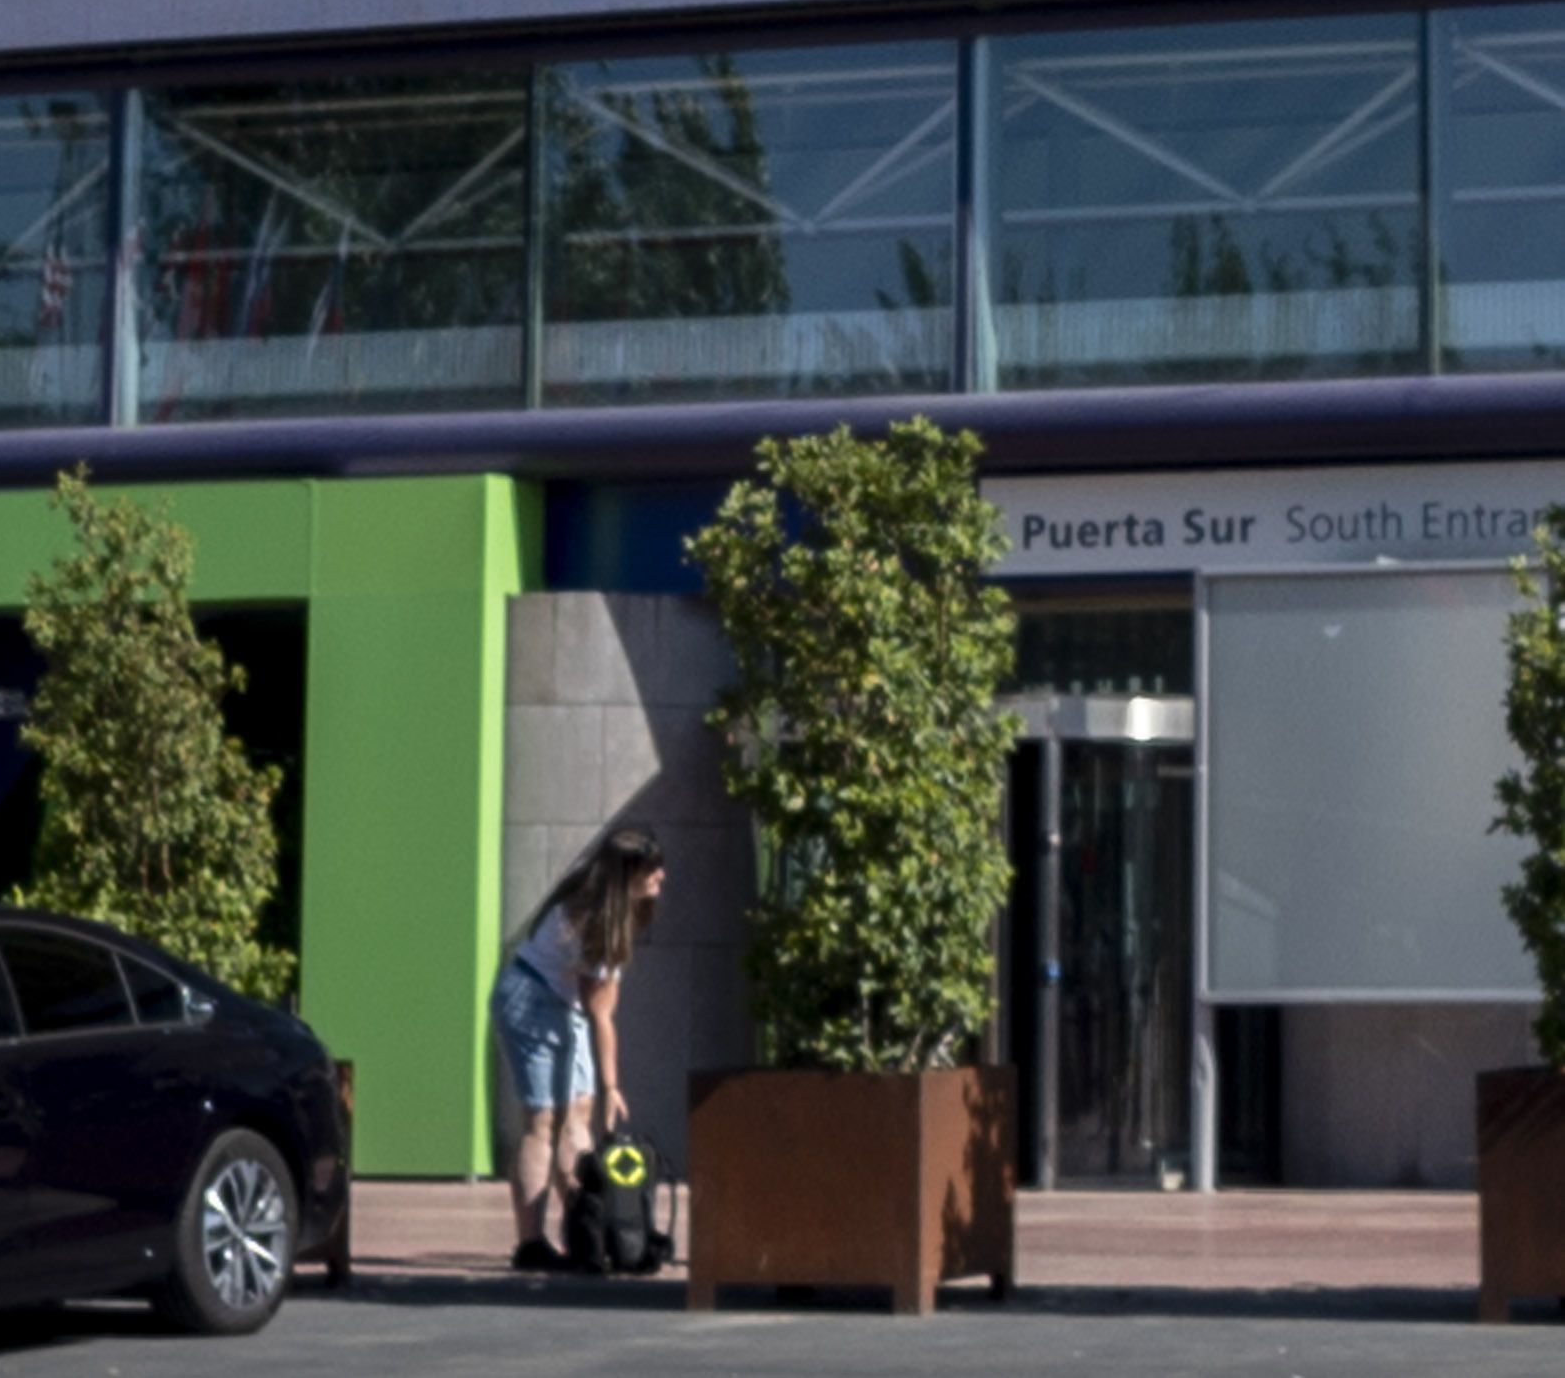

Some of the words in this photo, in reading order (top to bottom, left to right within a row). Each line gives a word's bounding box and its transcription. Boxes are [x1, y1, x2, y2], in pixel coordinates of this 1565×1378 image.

[1022, 513, 1165, 550] Puerta
[1182, 507, 1256, 545] Sur
[1286, 501, 1404, 543] South
